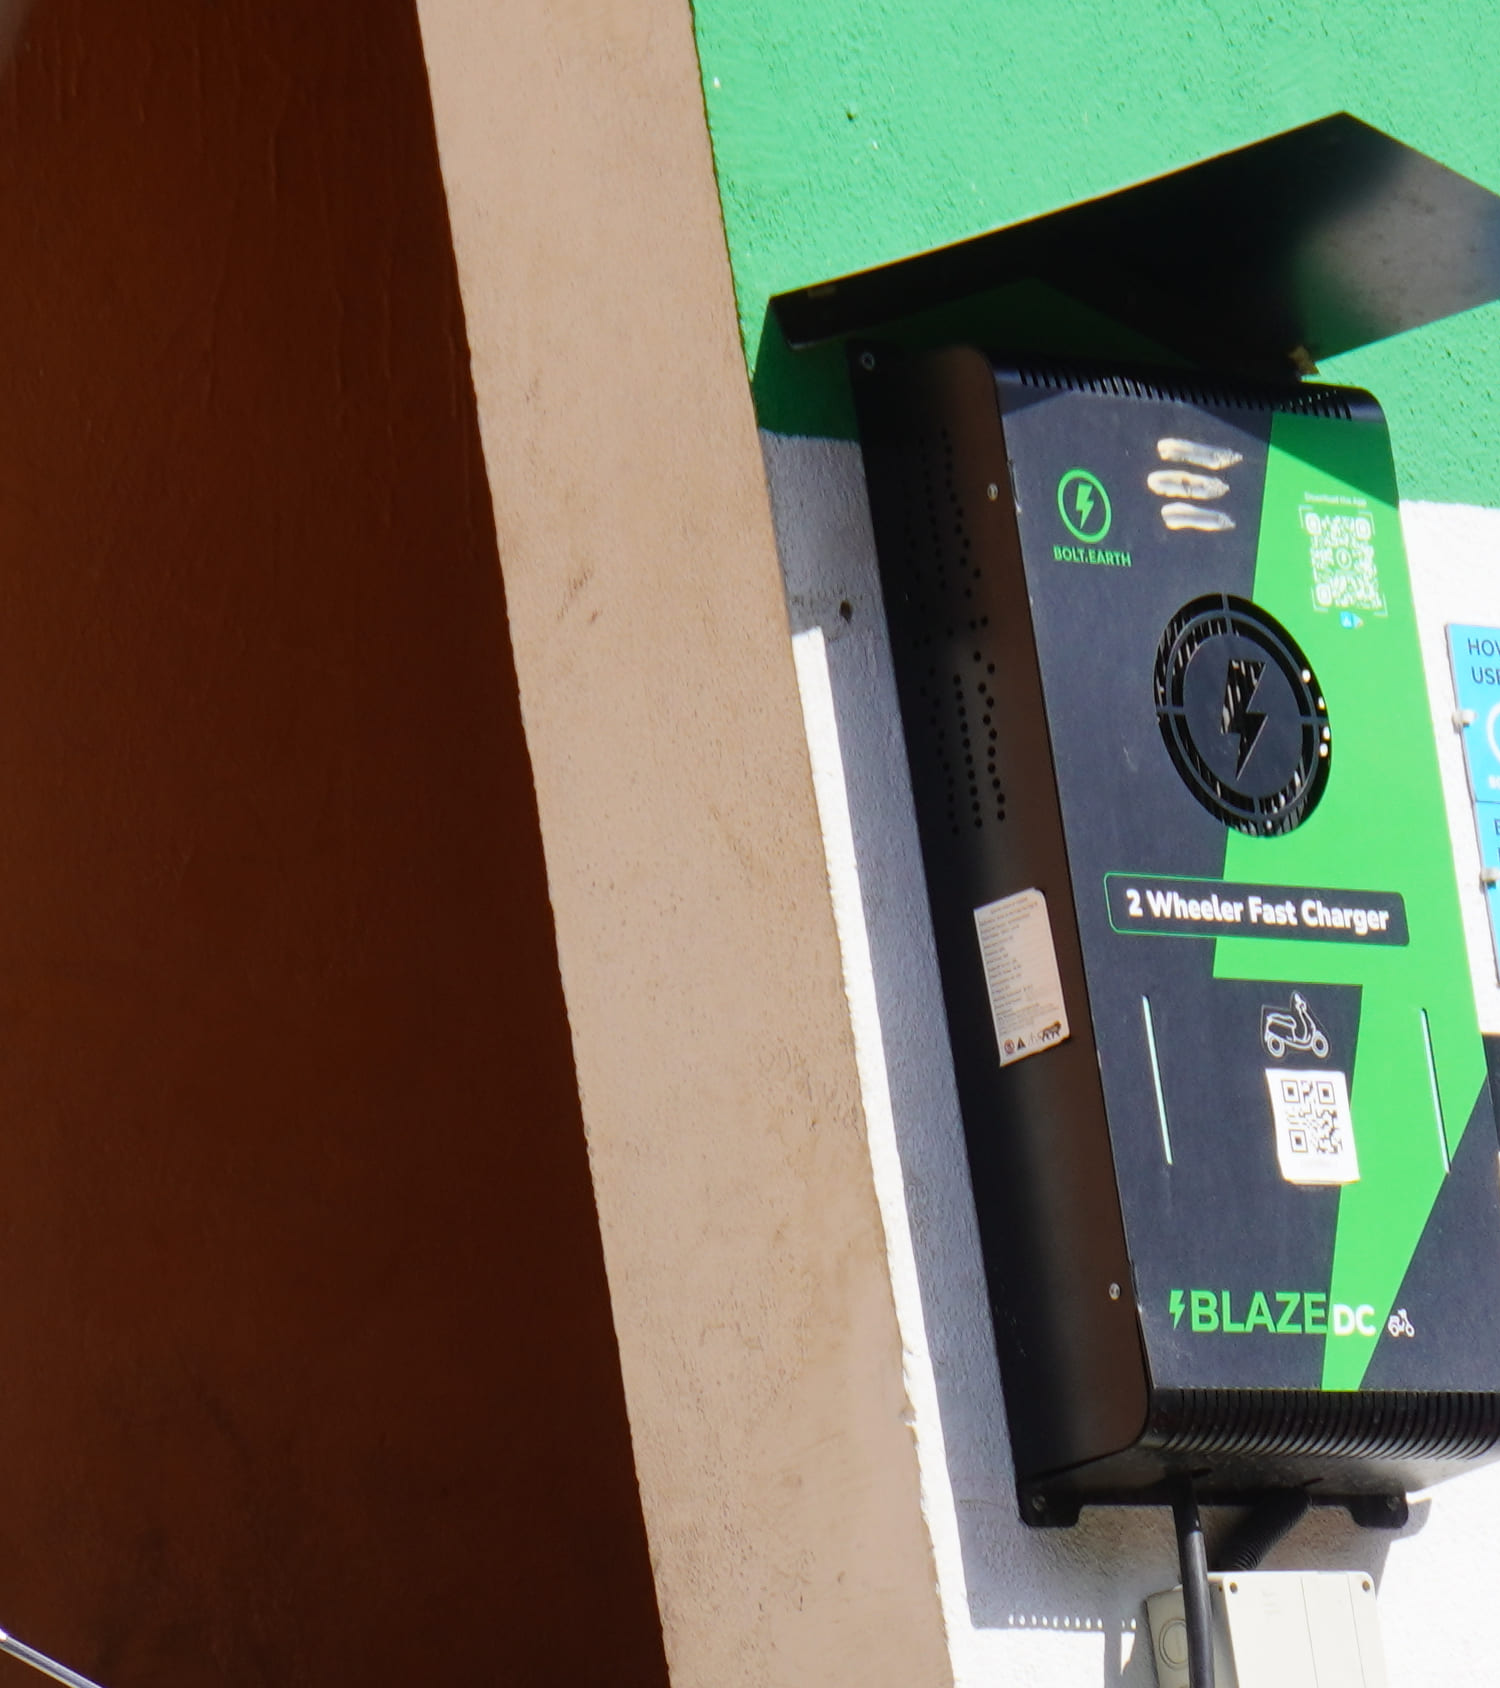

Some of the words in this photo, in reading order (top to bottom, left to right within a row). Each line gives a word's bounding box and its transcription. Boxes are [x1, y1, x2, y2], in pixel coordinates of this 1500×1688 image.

[1053, 545, 1132, 568] BOLT.EARTH
[1126, 888, 1143, 918] 2
[1147, 889, 1244, 924] Wheeler
[1249, 895, 1297, 927] Fast
[1301, 897, 1389, 933] Charger
